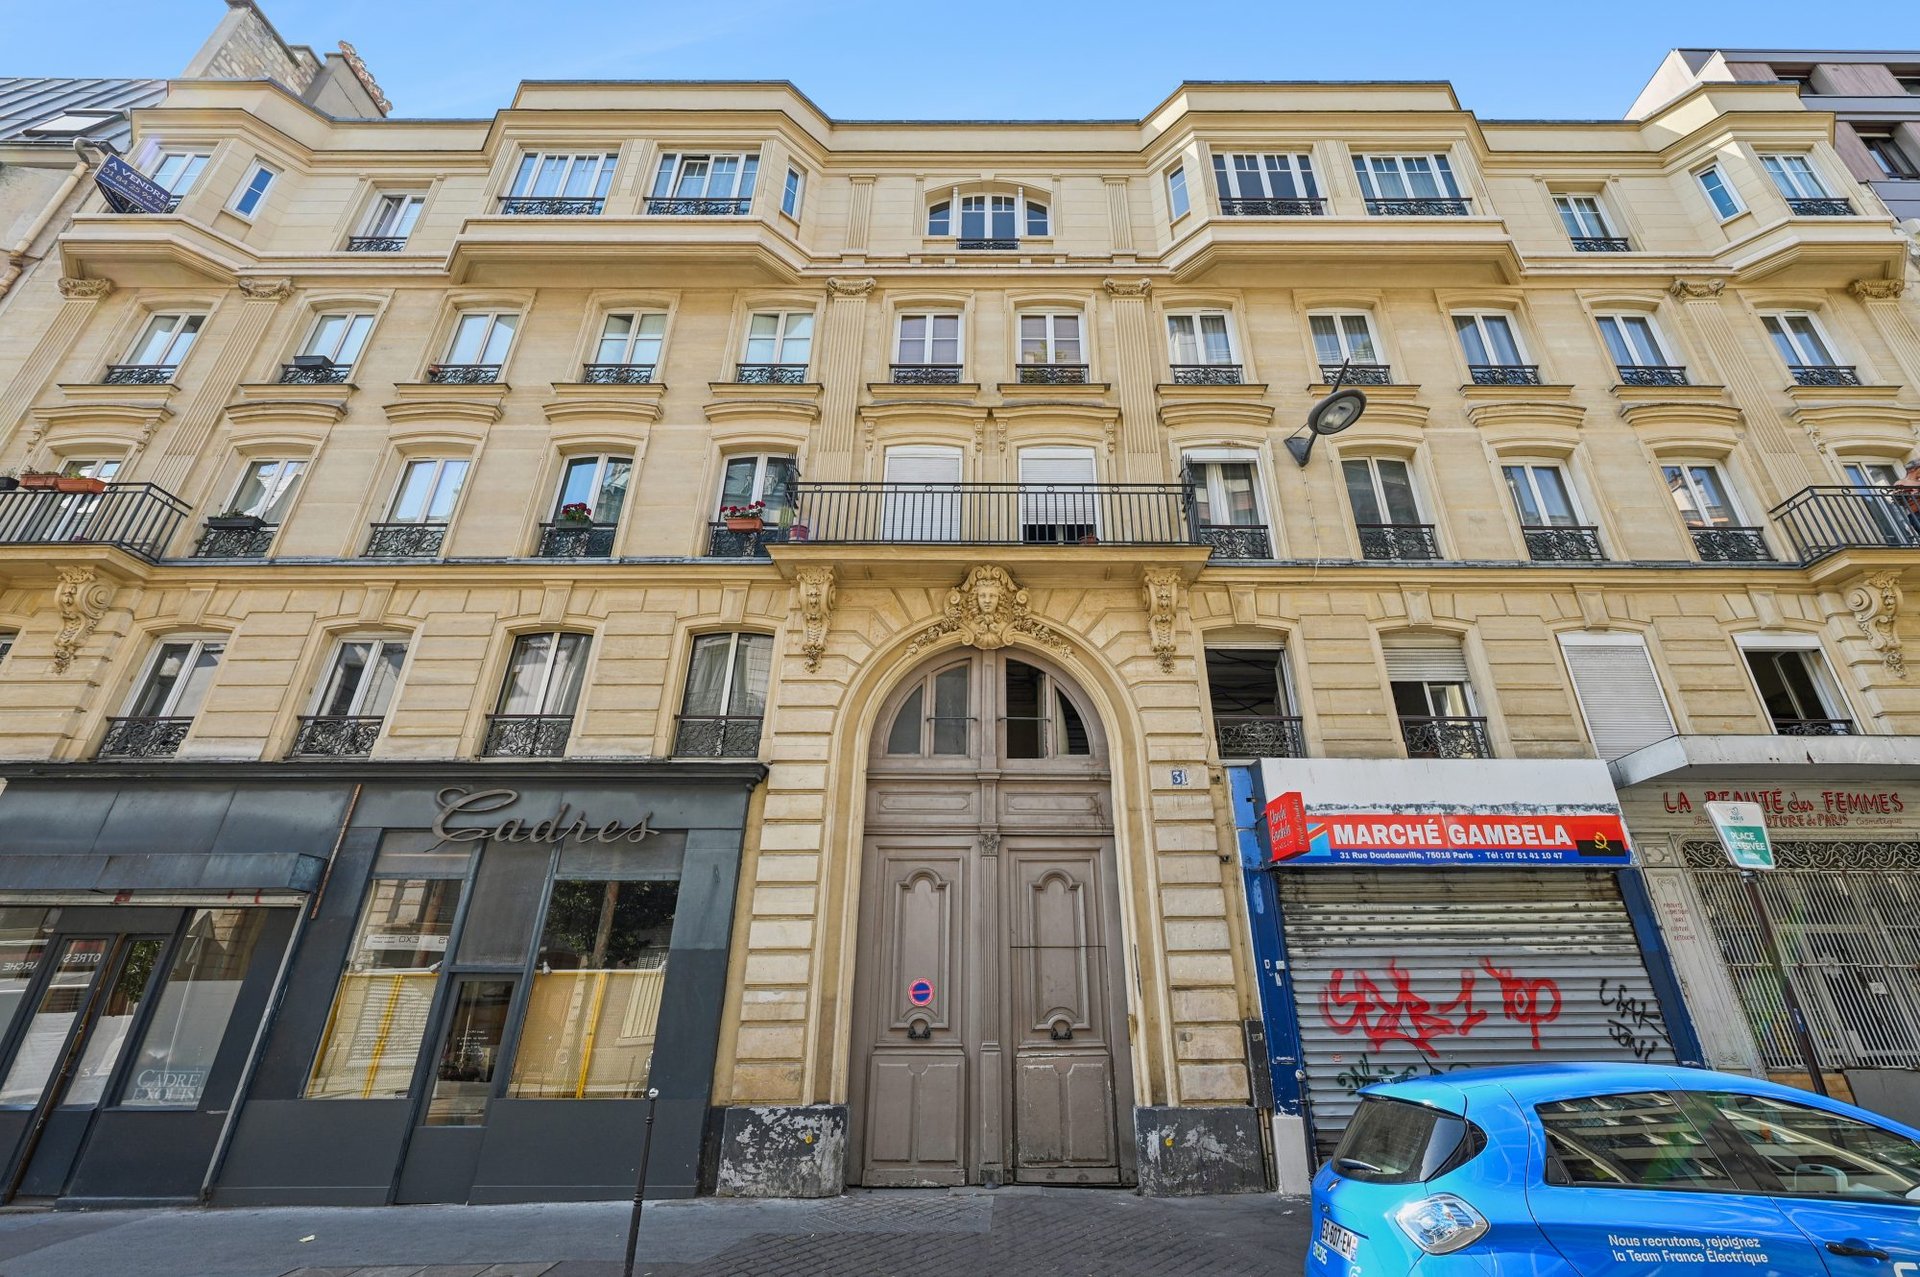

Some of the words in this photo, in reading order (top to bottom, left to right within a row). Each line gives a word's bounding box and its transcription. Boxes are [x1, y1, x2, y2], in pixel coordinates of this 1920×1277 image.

[102, 167, 114, 176] 01
[128, 183, 141, 193] 25
[141, 191, 153, 201] 96
[121, 168, 168, 202] VENDRE
[1663, 791, 1692, 813] LA
[1788, 791, 1815, 813] des
[1821, 791, 1904, 814] FEMMES
[424, 787, 661, 852] Cadres
[1817, 813, 1849, 827] PARIS
[1333, 818, 1442, 845] MARCHÉ
[1448, 824, 1573, 846] GAMBELA
[1730, 831, 1756, 841] PLACE
[1340, 851, 1350, 859] 31
[1352, 851, 1368, 859] Rue
[1369, 851, 1425, 860] Doudeauville,
[1426, 851, 1451, 859] 75018
[1453, 851, 1474, 859] Paris
[1485, 851, 1498, 859] Tél
[137, 1068, 201, 1088] CADRE
[1608, 1234, 1640, 1247] Nous
[1643, 1236, 1705, 1249] recrutons,
[1706, 1235, 1761, 1250] rejoignez
[1613, 1249, 1626, 1262] la
[1626, 1249, 1661, 1262] Team
[1662, 1249, 1705, 1263] France
[1706, 1247, 1768, 1266] Électrique
